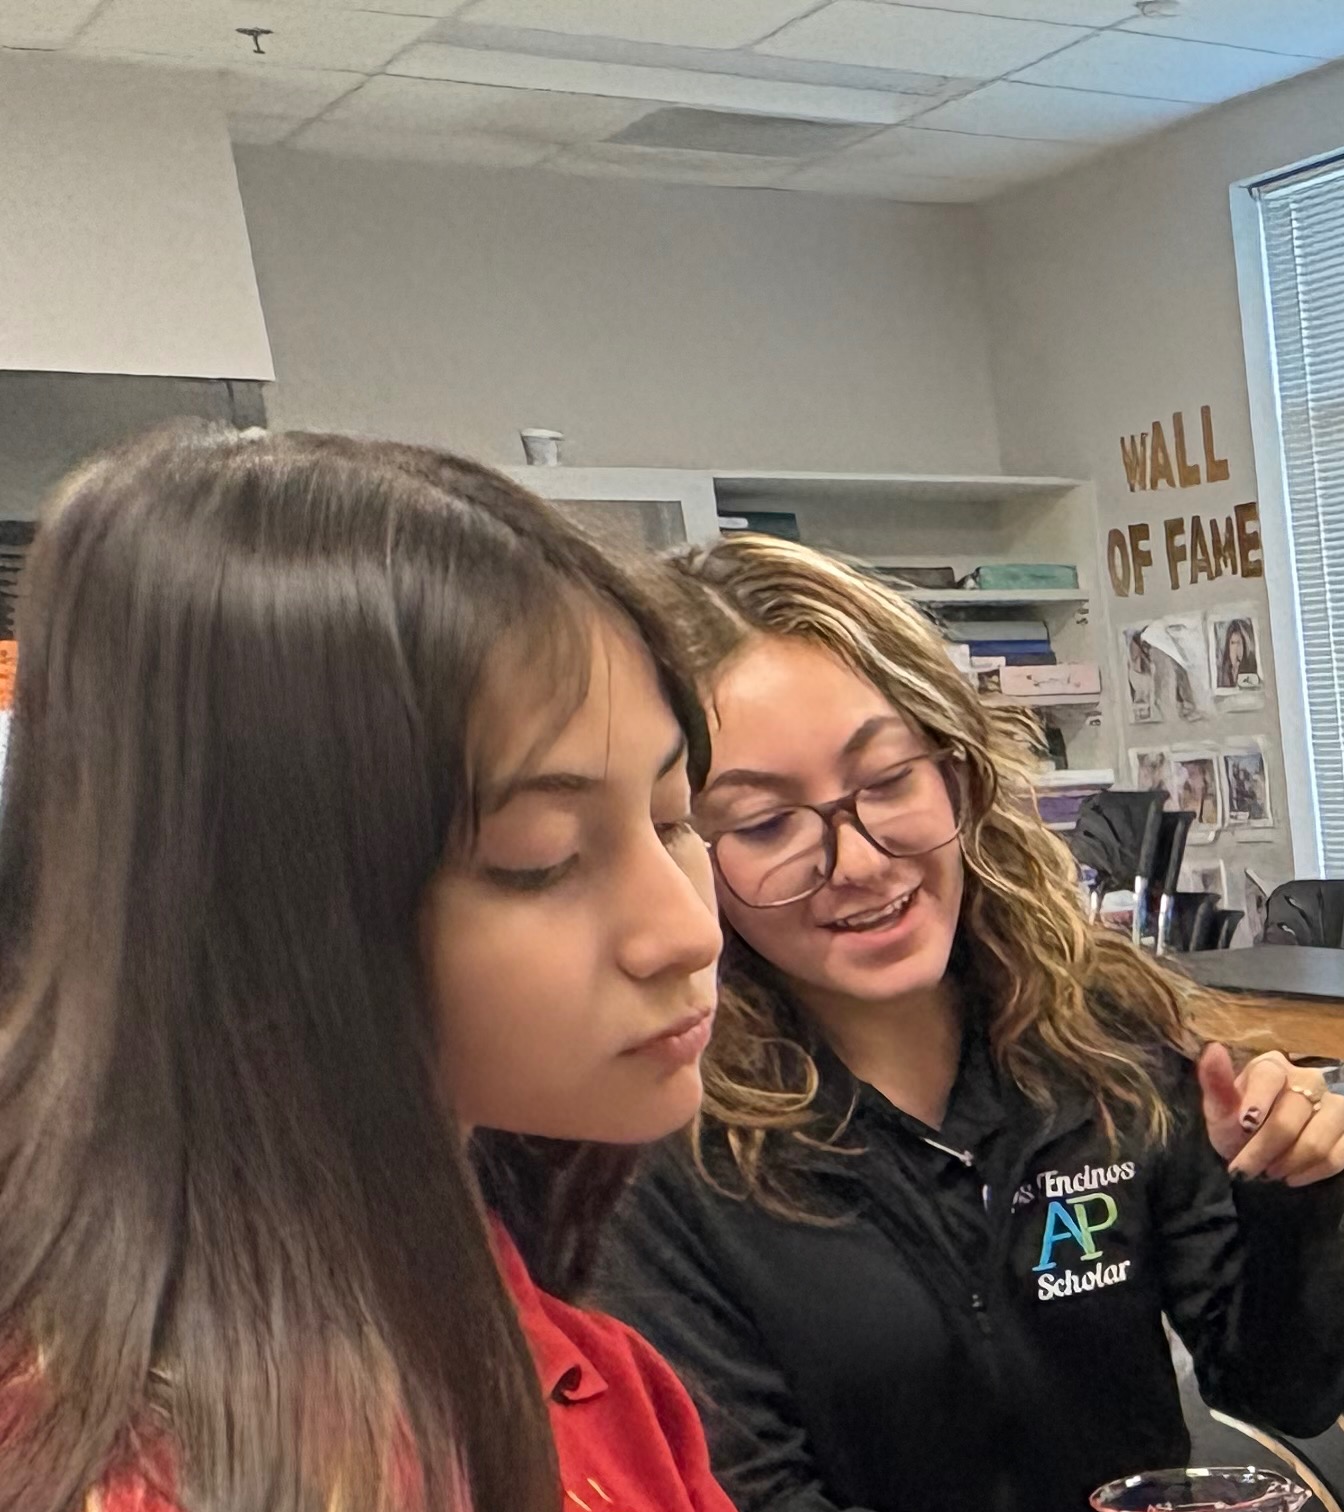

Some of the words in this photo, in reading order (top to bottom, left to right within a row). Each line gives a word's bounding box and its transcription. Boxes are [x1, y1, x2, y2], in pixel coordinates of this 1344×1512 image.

[1120, 404, 1230, 493] WALL
[1107, 523, 1153, 598] OF
[1163, 501, 1262, 590] FAME
[1031, 1192, 1119, 1272] AP
[1037, 1259, 1131, 1301] Scholar
